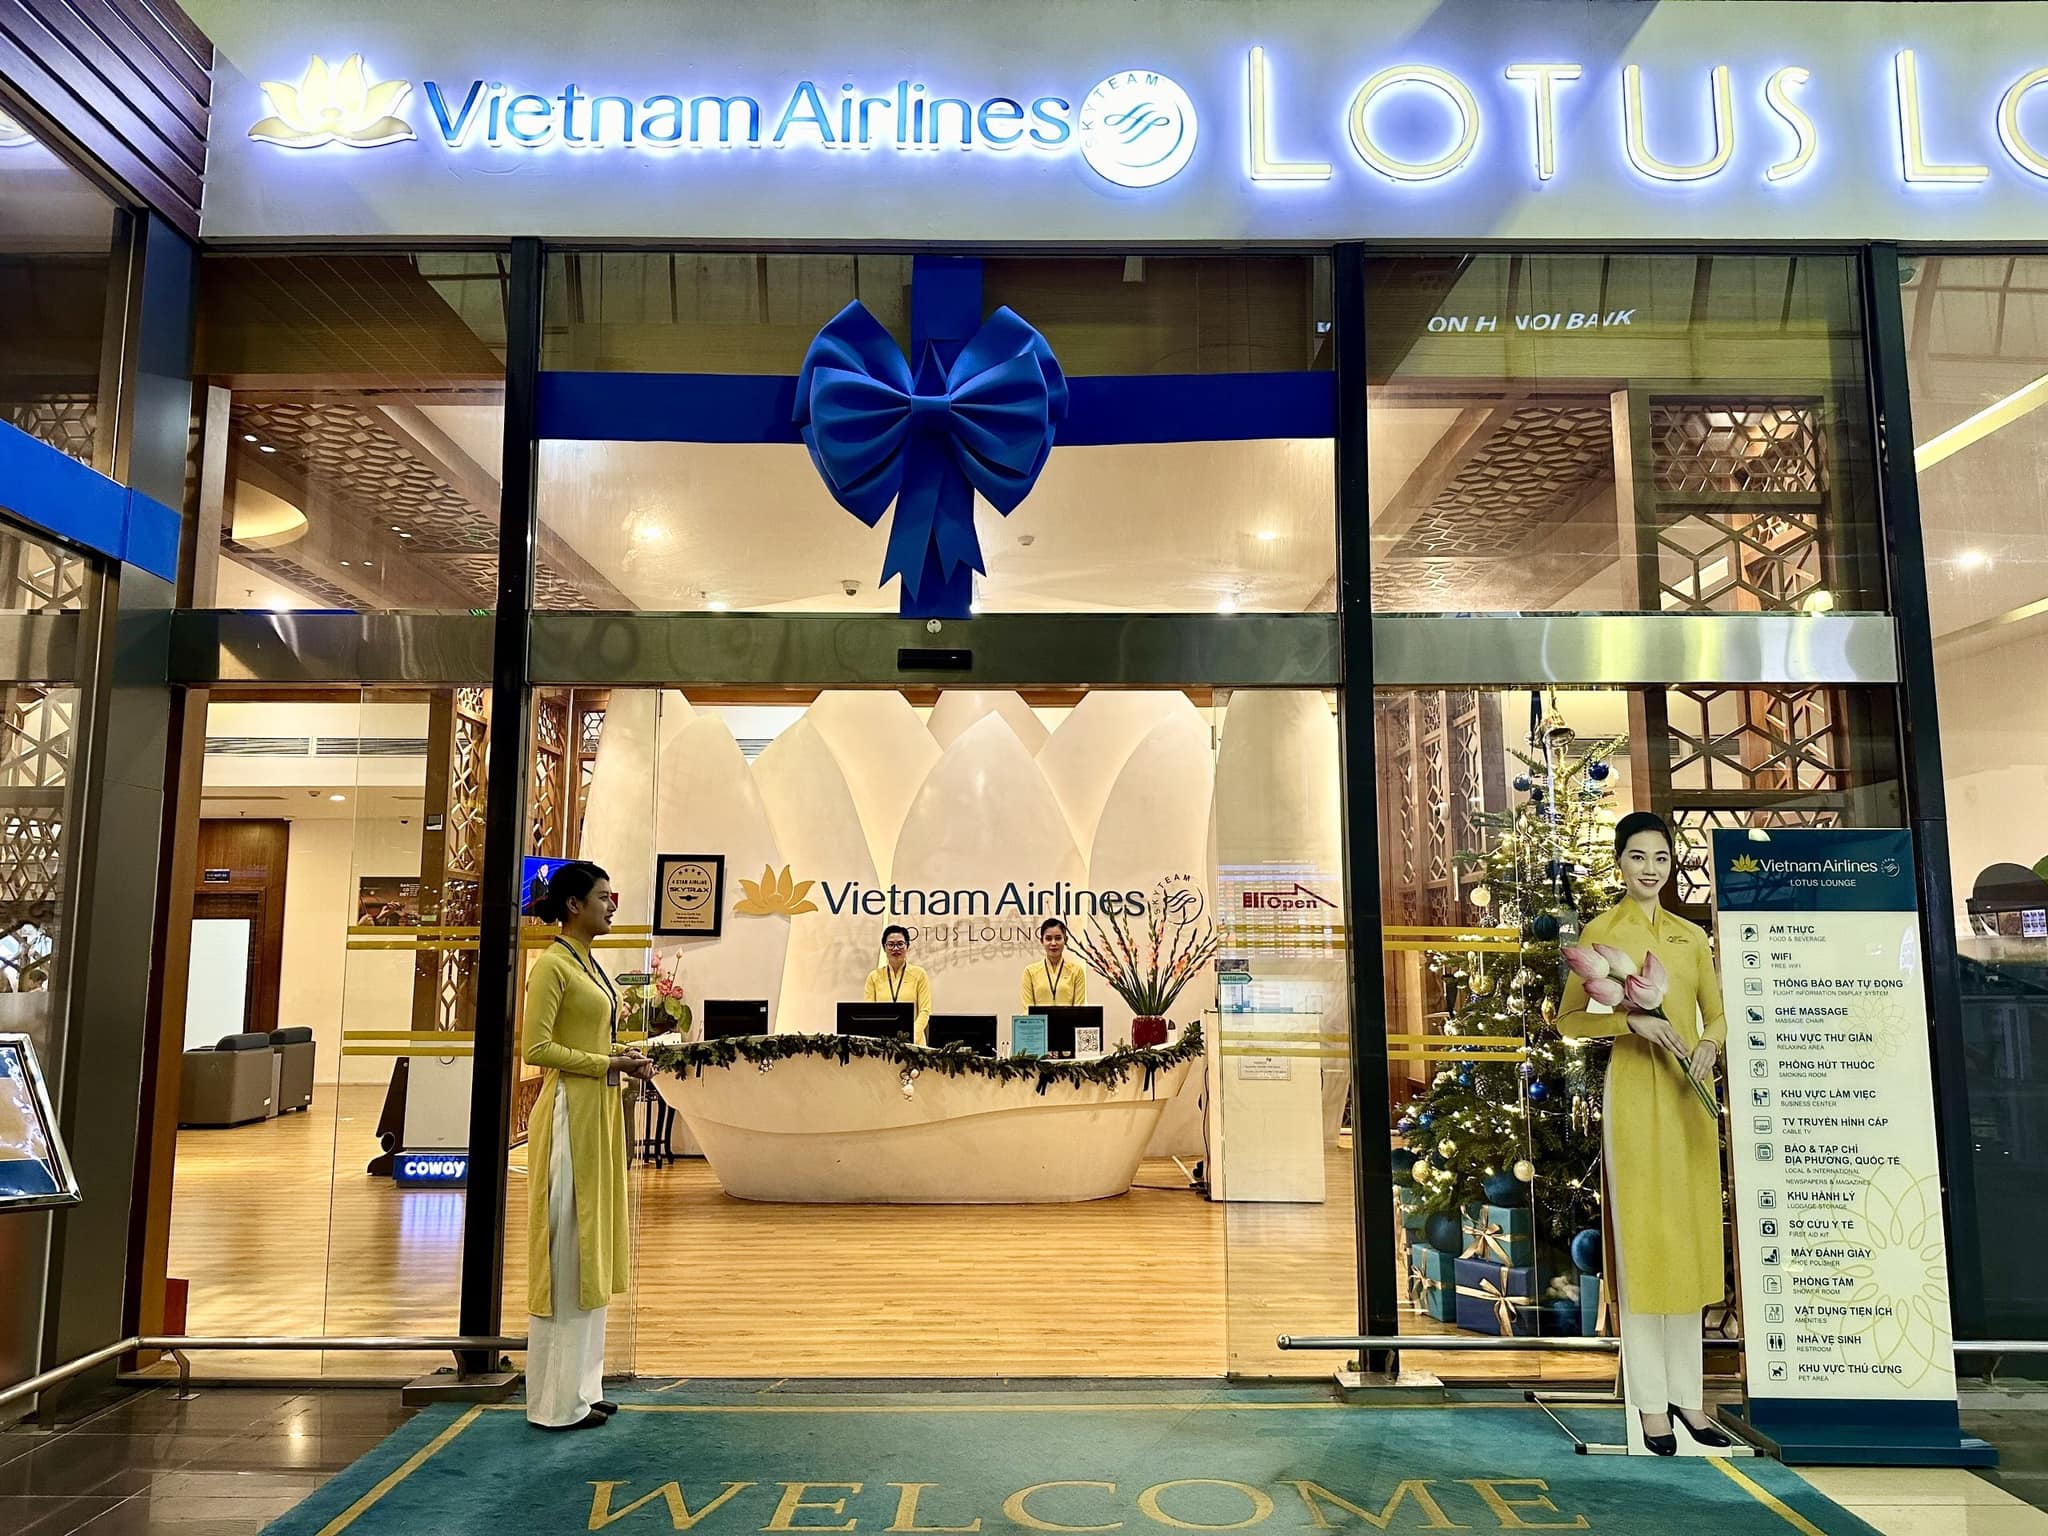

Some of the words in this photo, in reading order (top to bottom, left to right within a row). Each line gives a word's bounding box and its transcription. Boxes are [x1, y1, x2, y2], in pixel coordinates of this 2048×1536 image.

[423, 79, 761, 147] Vietnam
[772, 79, 1071, 147] Airlines
[1081, 73, 1159, 150] SKYTEAM
[1249, 46, 1816, 182] LOTUS
[1760, 858, 1822, 873] Vietnam
[1823, 858, 1878, 873] Airlines
[1790, 879, 1818, 887] LOTUS
[1821, 879, 1856, 887] LOUNGE
[821, 880, 991, 916] Vietnam
[999, 881, 1145, 917] Airlines
[1152, 873, 1191, 915] SKYTEAM
[908, 926, 959, 942] OTUS
[968, 925, 1041, 942] LOUN
[1776, 1033, 1797, 1041] KHU
[1781, 1090, 1802, 1098] KHU
[1783, 1118, 1795, 1126] TV
[1787, 1192, 1808, 1200] KHU
[1832, 1220, 1838, 1229] Y
[1837, 1336, 1861, 1344] SINH
[1799, 1364, 1820, 1372] KHU
[585, 1479, 1591, 1533] WELCOME
